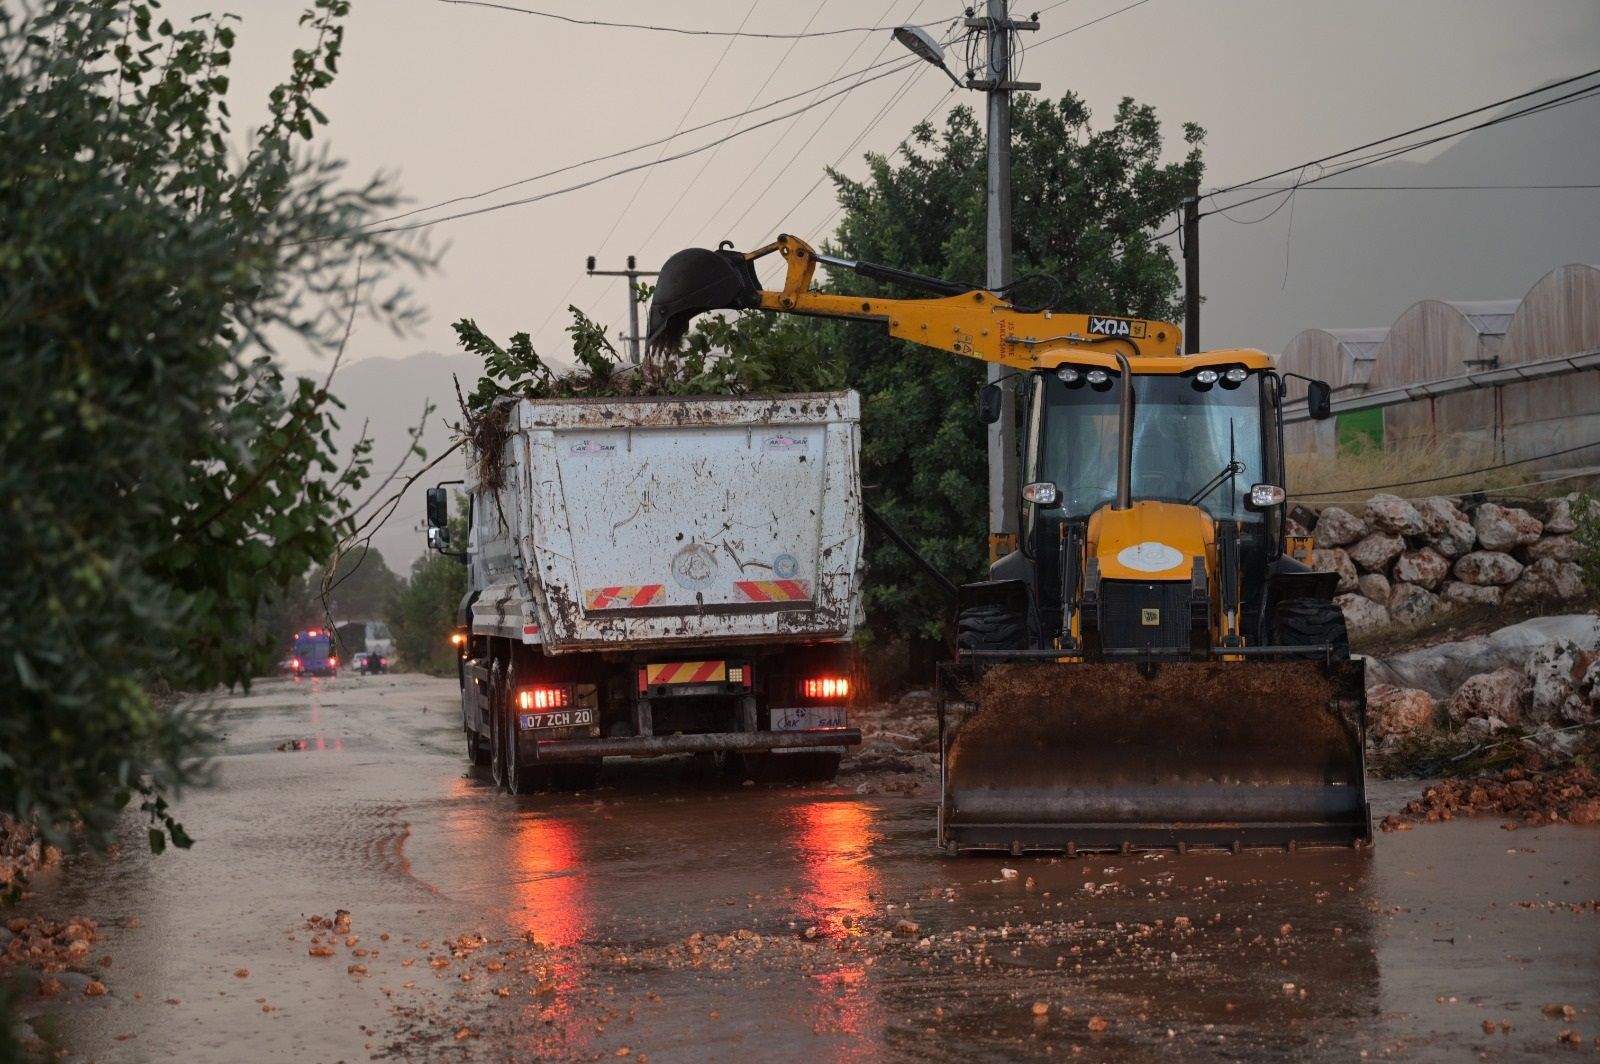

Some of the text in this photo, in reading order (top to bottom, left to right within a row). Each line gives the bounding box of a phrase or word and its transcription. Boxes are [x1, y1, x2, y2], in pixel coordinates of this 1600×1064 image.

[527, 716, 542, 728] 07
[547, 713, 570, 726] ZCH
[574, 711, 590, 724] 20
